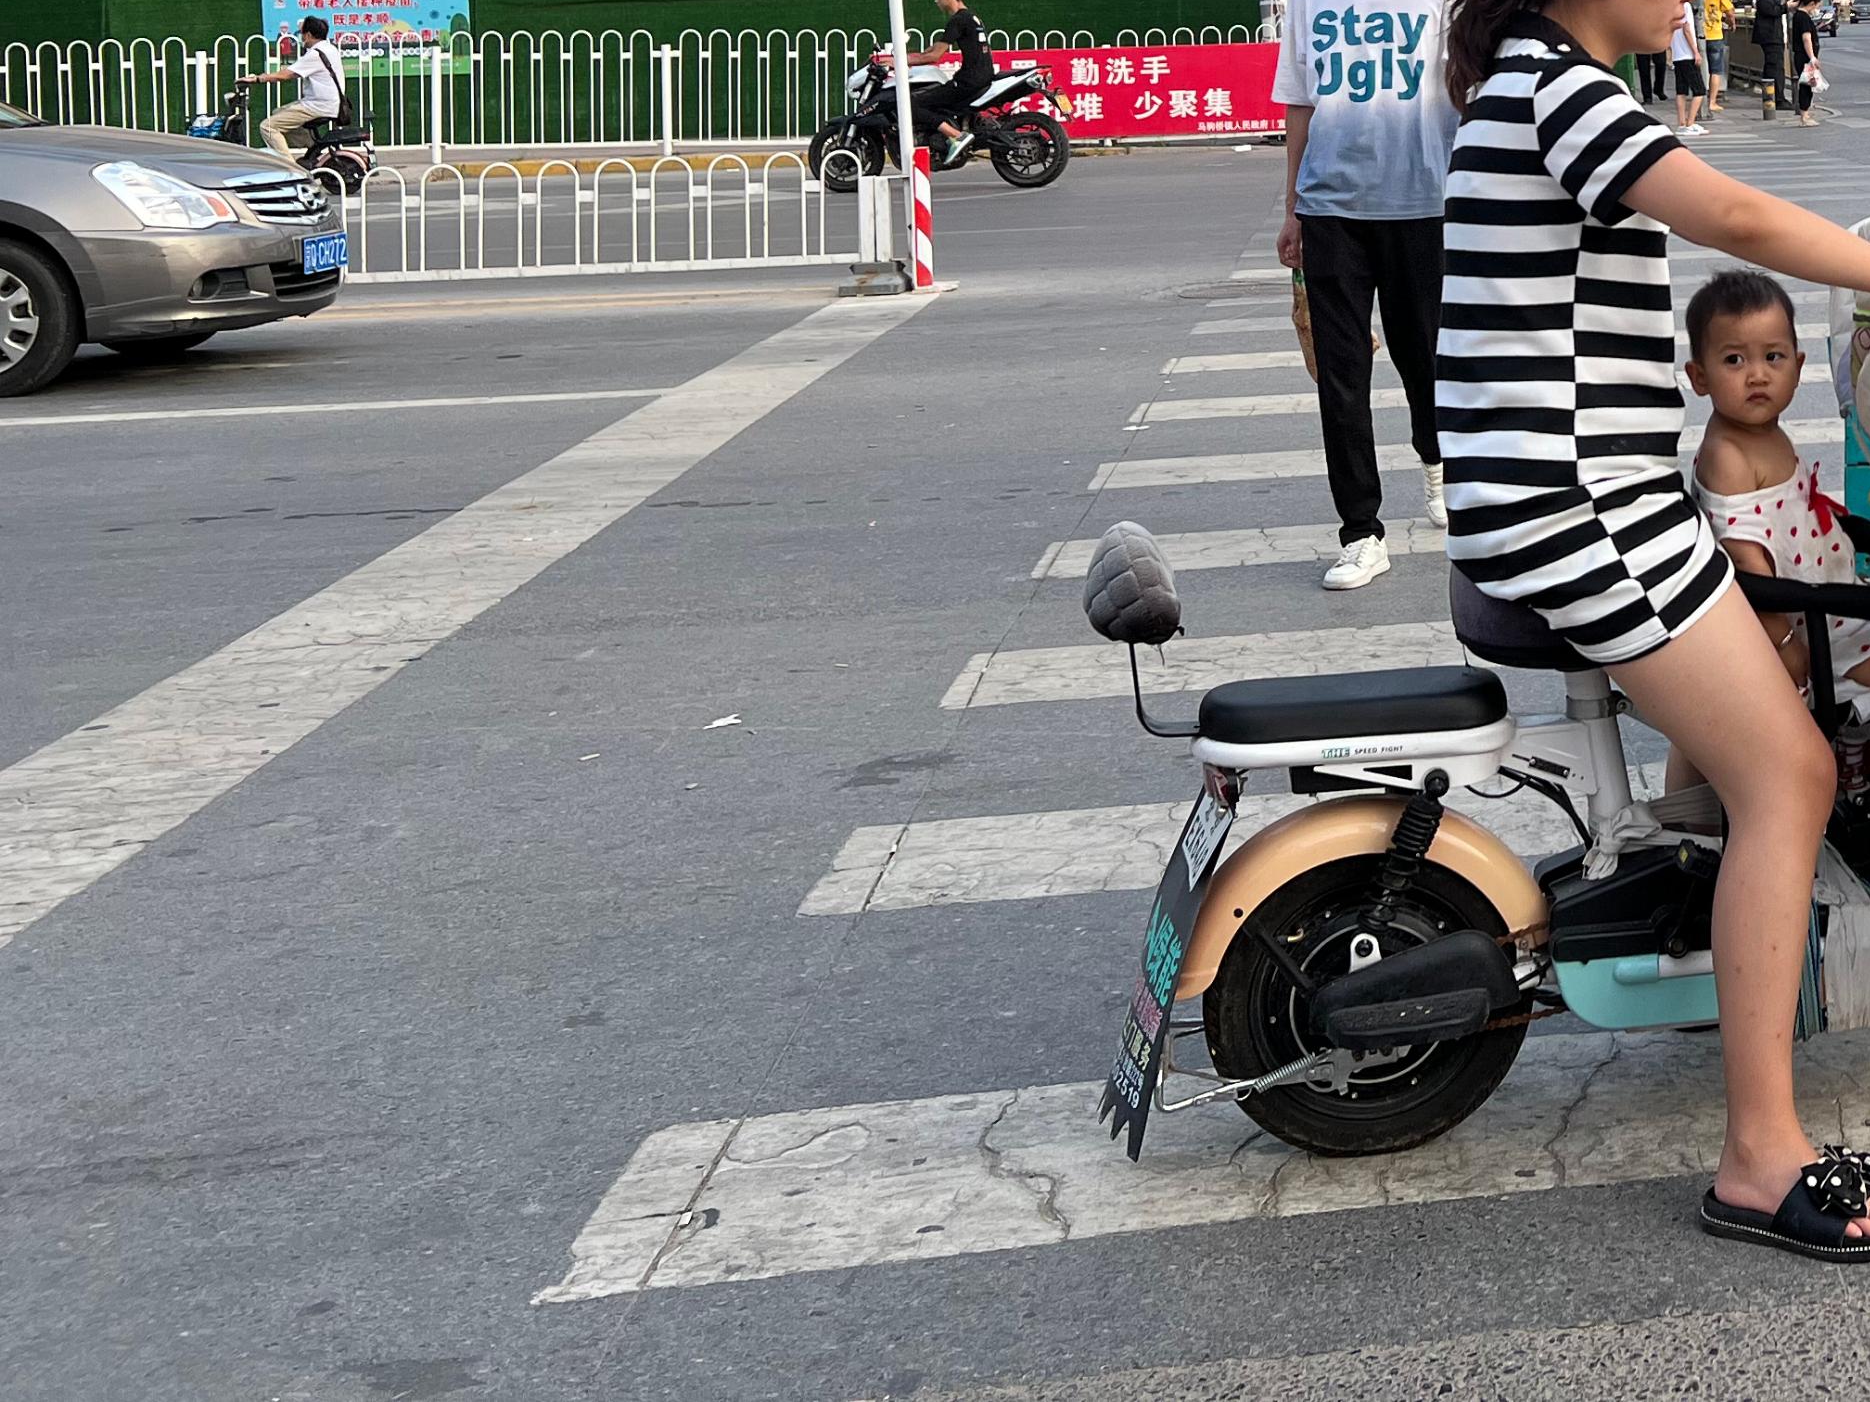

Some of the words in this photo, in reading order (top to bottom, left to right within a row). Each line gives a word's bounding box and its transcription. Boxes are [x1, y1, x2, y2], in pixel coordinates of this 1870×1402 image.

[1070, 56, 1171, 86] 勤洗手
[1314, 49, 1425, 103] Ugly
[1134, 88, 1233, 120] 少聚集
[1354, 747, 1377, 755] SPEED
[1381, 745, 1403, 753] FIGHT
